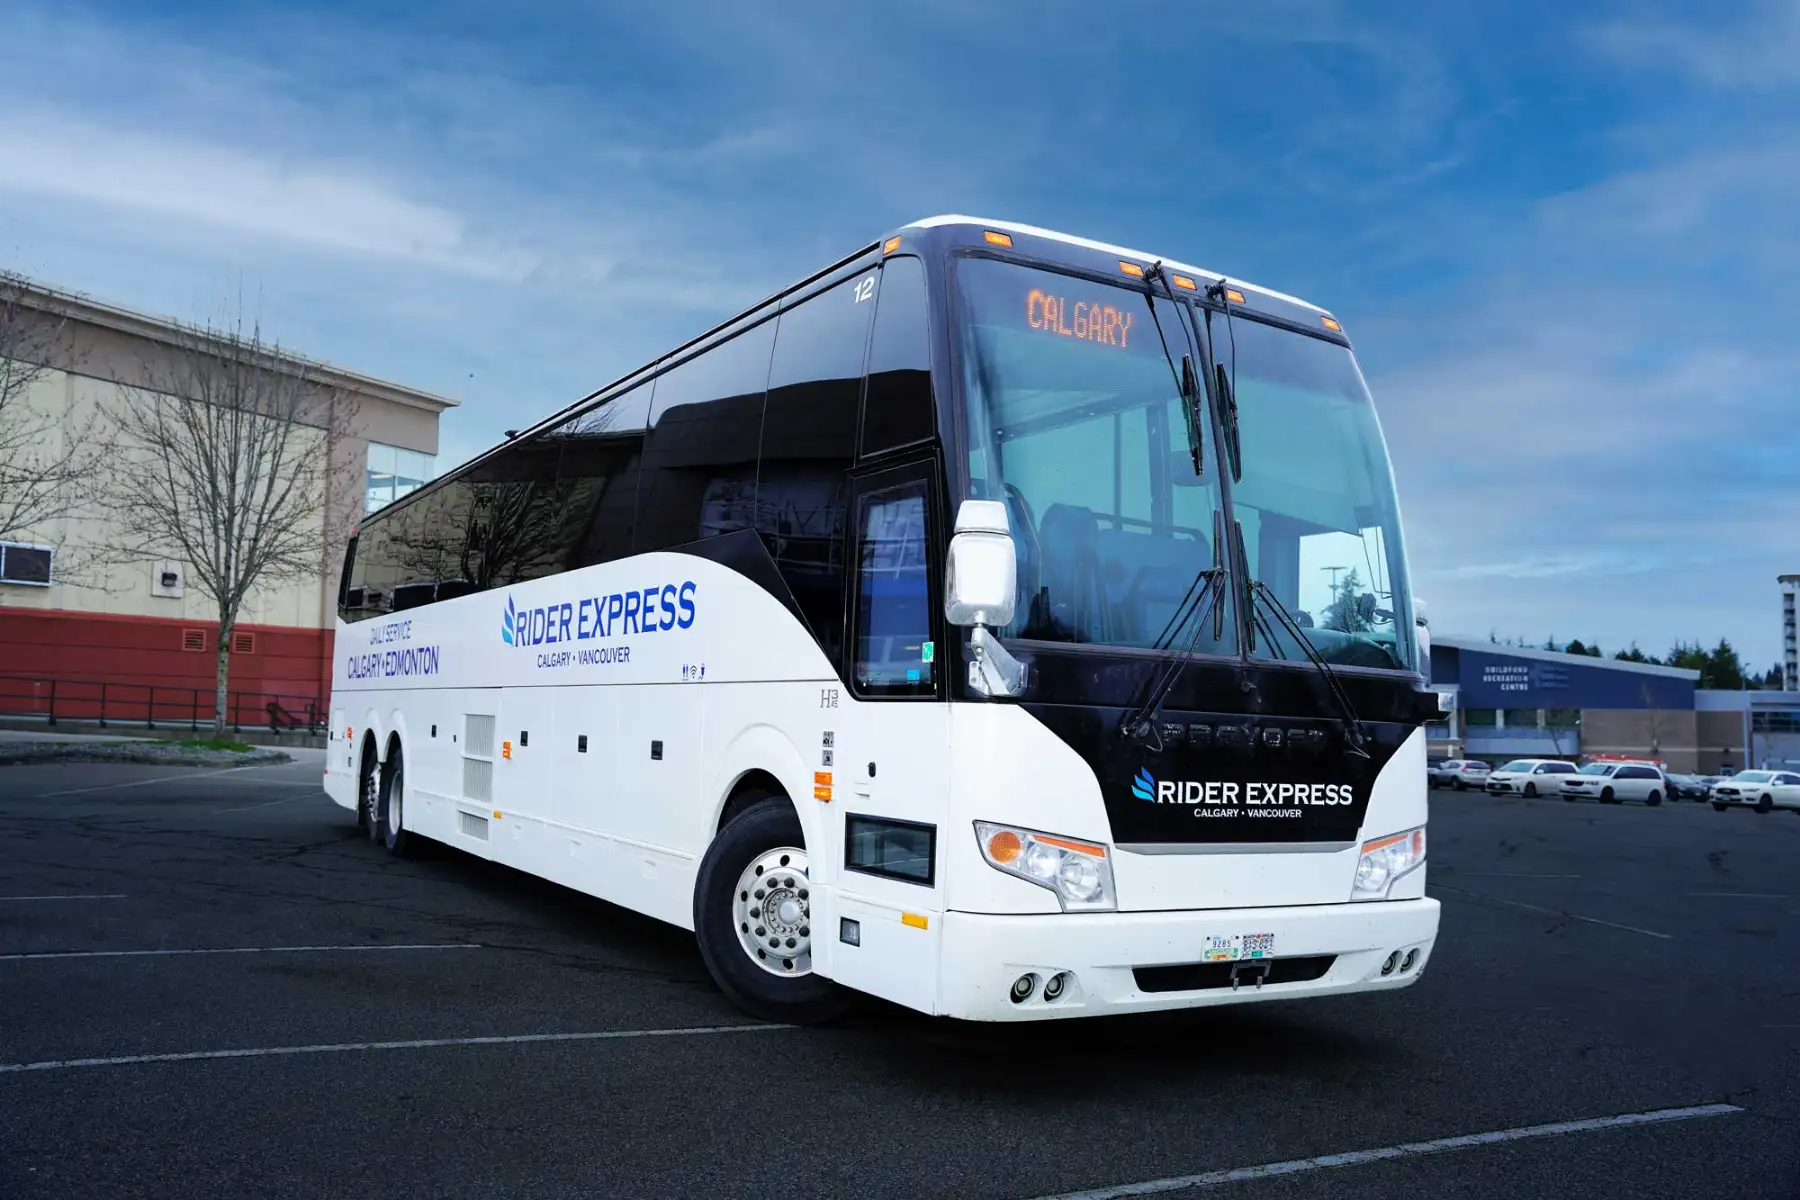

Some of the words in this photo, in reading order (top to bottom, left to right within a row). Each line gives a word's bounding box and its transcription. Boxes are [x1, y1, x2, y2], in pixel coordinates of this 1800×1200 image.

[854, 276, 875, 303] 12
[1027, 288, 1132, 347] CALGARY
[515, 602, 573, 647] RIDER
[577, 581, 697, 640] EXPRESS
[385, 620, 412, 642] SERVICE
[348, 652, 383, 679] CALGARY
[385, 645, 439, 677] EDMONTON
[537, 651, 571, 668] CALGARY
[578, 646, 630, 664] VANCOUVER
[1157, 780, 1239, 804] RIDER
[1245, 782, 1353, 806] EXPRESS
[1194, 808, 1239, 818] CALGARY
[1247, 809, 1302, 818] VANCOUVER
[1212, 940, 1231, 948] 9285
